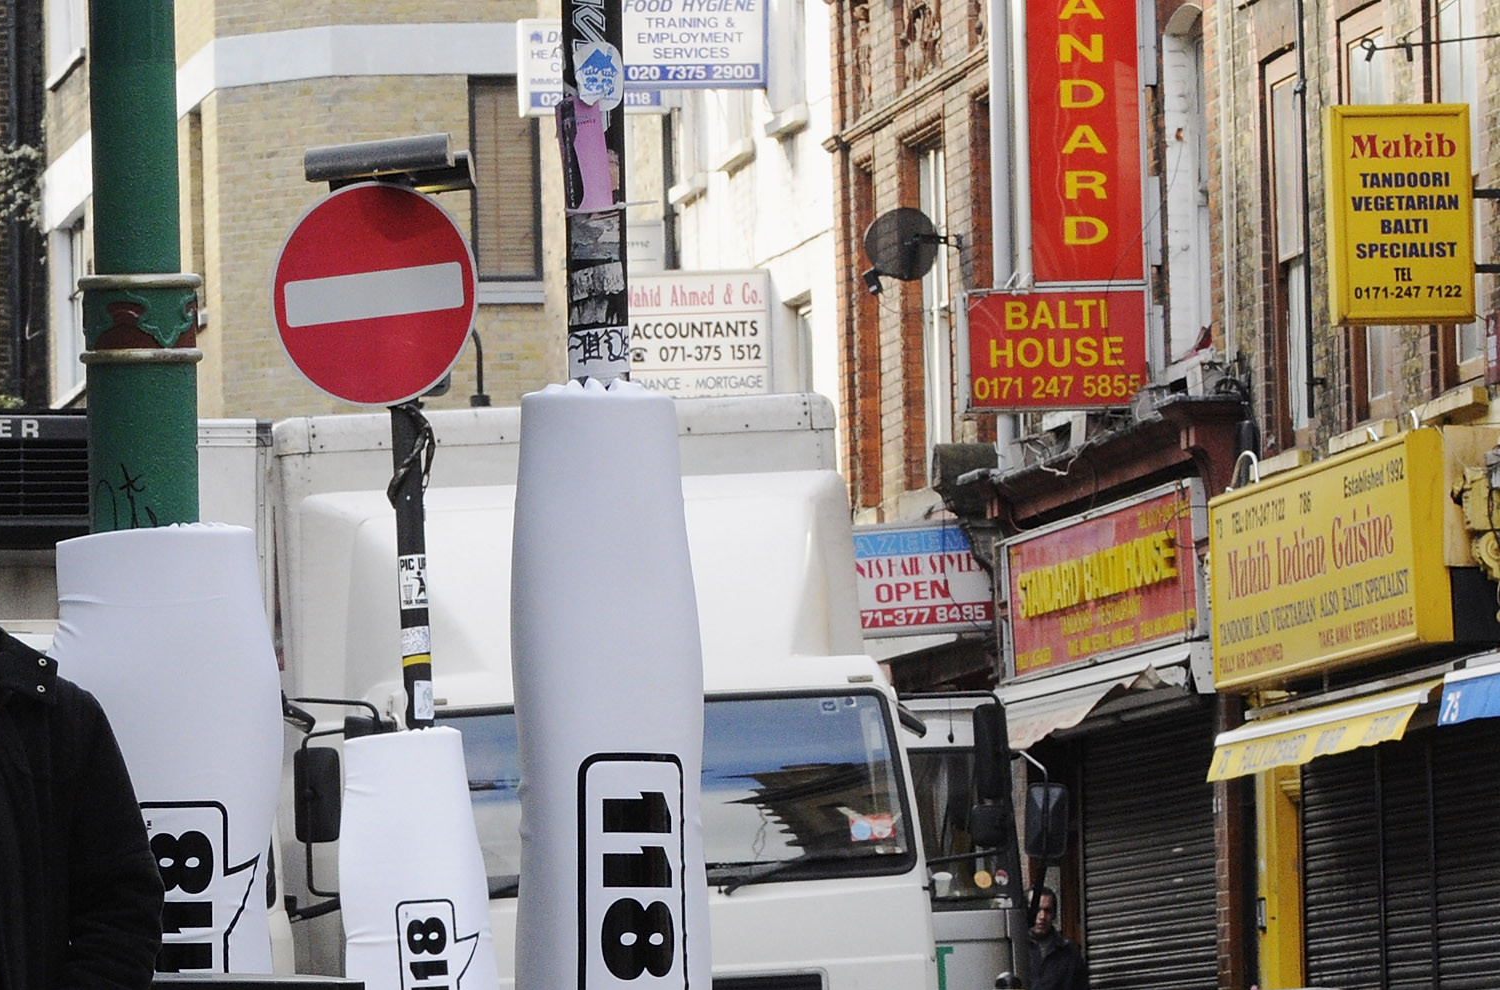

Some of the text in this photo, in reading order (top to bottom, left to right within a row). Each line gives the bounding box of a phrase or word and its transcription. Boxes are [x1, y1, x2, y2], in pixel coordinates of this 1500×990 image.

[624, 0, 755, 12] FOOD HYGIENE
[646, 17, 735, 28] TRAINING &
[637, 32, 744, 44] EMPLOYMENT
[653, 47, 730, 59] SERVICES
[628, 65, 755, 80] 020 7375 2900
[540, 93, 561, 105] 02
[1350, 132, 1456, 159] Muhib
[1359, 172, 1450, 188] TANDOORI
[1351, 194, 1459, 211] VEGETARIAN
[1380, 218, 1428, 234] BALTI
[1355, 242, 1457, 259] SPECIALIST
[1394, 267, 1412, 282] TEL
[670, 284, 715, 307] Ahmed
[723, 282, 733, 305] &
[741, 282, 763, 305] Co.
[1354, 285, 1462, 299] 0171-247 7122
[1005, 299, 1108, 330] BALTI
[631, 320, 758, 340] ACCOUNTANTS
[659, 344, 761, 362] 071-375 1512
[989, 336, 1125, 368] HOUSE
[695, 375, 763, 389] MORTGAGE
[974, 374, 1141, 400] 0171 247 5855
[1343, 463, 1384, 498] Established
[1385, 456, 1404, 484] 1992
[1276, 525, 1326, 588] Indian
[1331, 504, 1394, 571] Cuisine
[1018, 530, 1177, 619] STANDARD BALTI HOUSE
[875, 579, 951, 603] OPEN
[862, 604, 987, 628] 71-377 8495
[1219, 615, 1253, 646] TANDOORI
[1255, 610, 1270, 636] AND
[1271, 597, 1315, 633] VEGETARIAN
[1319, 590, 1339, 618] ALSO
[1342, 581, 1364, 611] BALTI
[1365, 568, 1409, 605] SPECIALIST
[1353, 615, 1379, 640] SERVICE
[1379, 606, 1413, 633] AVAILABLE
[1442, 691, 1462, 722] 75
[601, 792, 675, 981] 118
